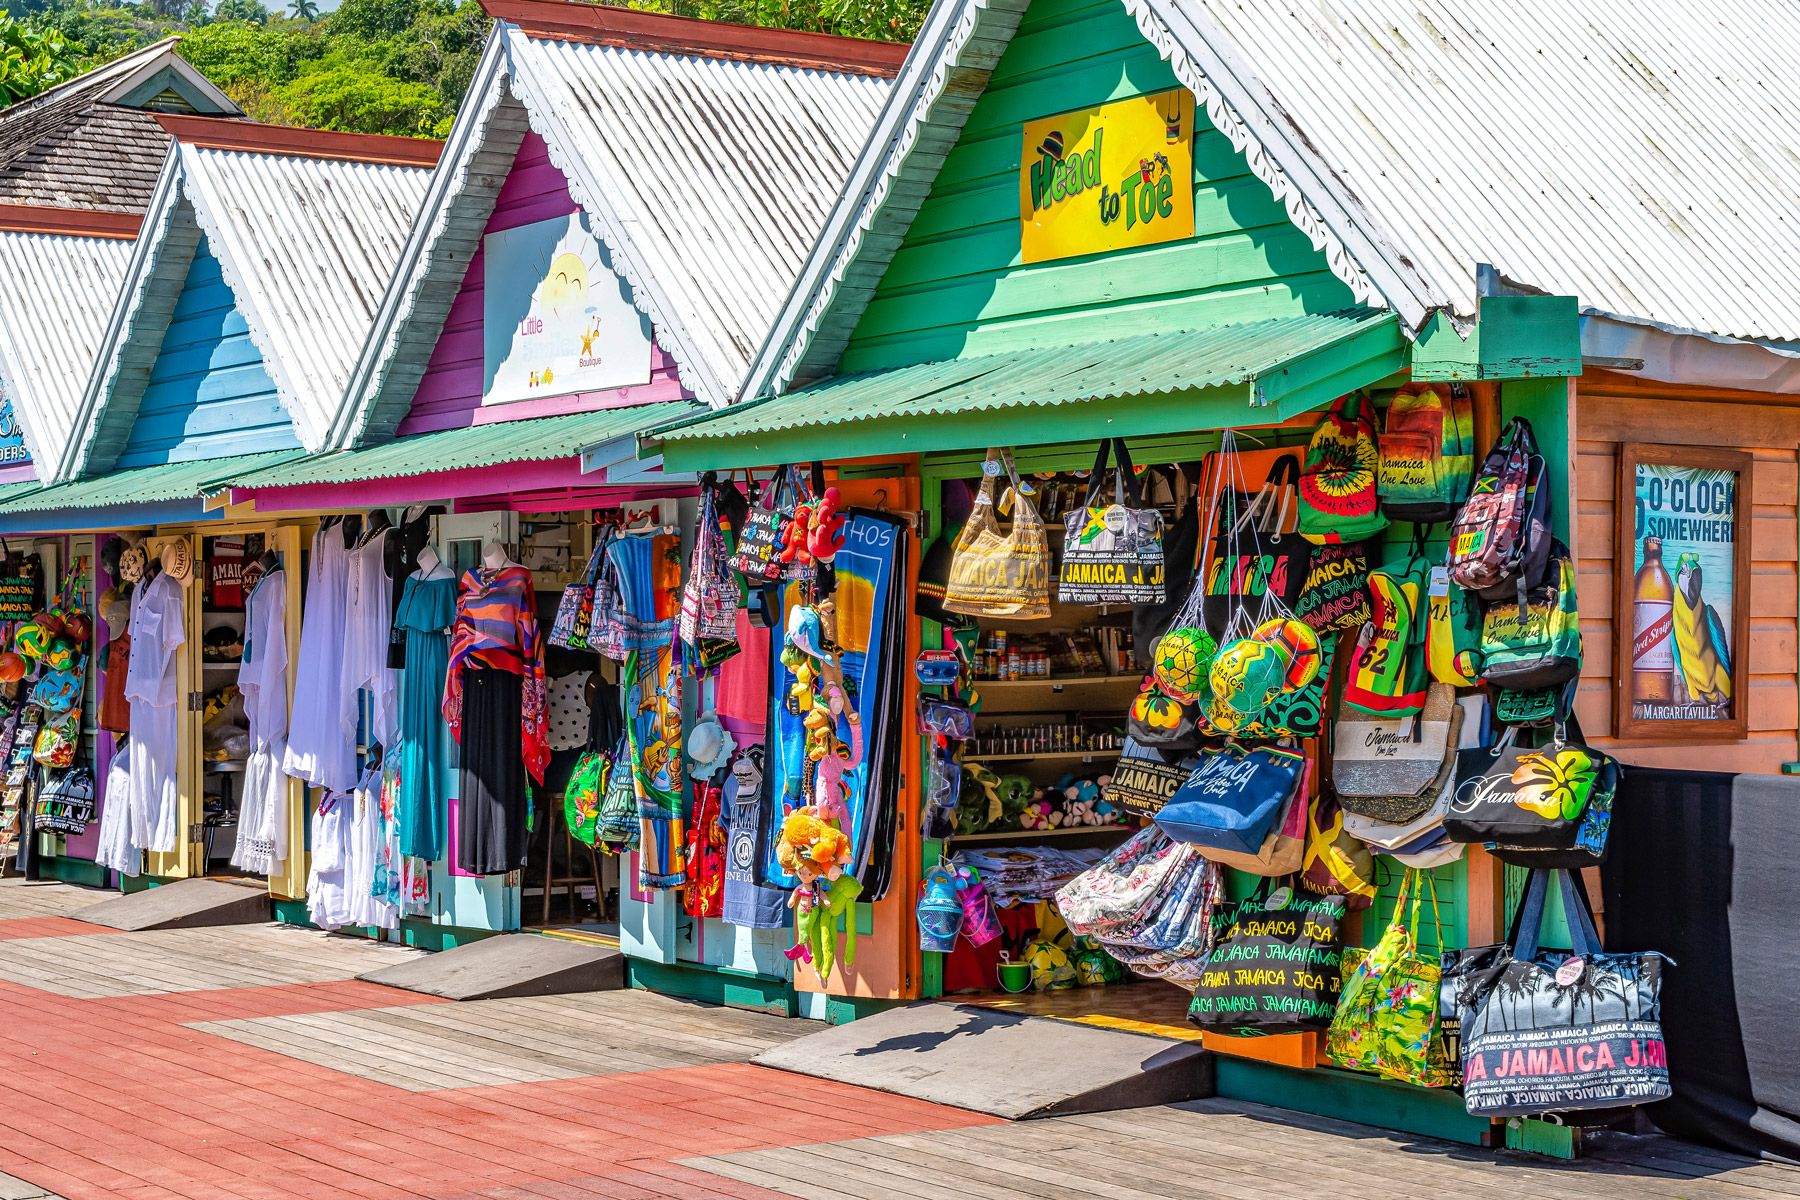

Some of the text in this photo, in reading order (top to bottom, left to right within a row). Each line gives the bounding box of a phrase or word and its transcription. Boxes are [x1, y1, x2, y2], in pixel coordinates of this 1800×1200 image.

[1031, 127, 1103, 211] Head
[1099, 169, 1173, 231] to Toe
[521, 316, 543, 336] Little
[579, 357, 602, 368] Boutique
[1381, 454, 1425, 470] Jamaica
[1380, 470, 1426, 485] One Love
[1066, 563, 1127, 585] JAMAICA
[1489, 613, 1541, 630] Jamaca
[1649, 617, 1673, 643] Strip
[1486, 626, 1541, 645] One Love
[1359, 646, 1390, 676] 62
[1205, 706, 1247, 720] JAMAICA
[1116, 768, 1184, 798] JAMAIC
[1202, 784, 1229, 799] Only
[1450, 773, 1562, 814] Jamaica
[725, 871, 754, 883] ONE LO
[1303, 877, 1340, 896] JAMAICA
[1234, 968, 1286, 988] JAMAICA
[1215, 995, 1258, 1013] JAMAICA
[1481, 1023, 1628, 1045] JAMAICA JAMAICA JAMAICA JAMAICA
[1494, 1041, 1616, 1078] JAMAICA
[1479, 1086, 1503, 1094] JAMAICA
[1555, 1081, 1581, 1089] JAMAICA
[1582, 1078, 1609, 1087] JAMAICA
[1572, 1072, 1598, 1081] MONTEGO
[1511, 1089, 1563, 1105] JAMAICA
[1565, 1084, 1620, 1101] JAMAICA
